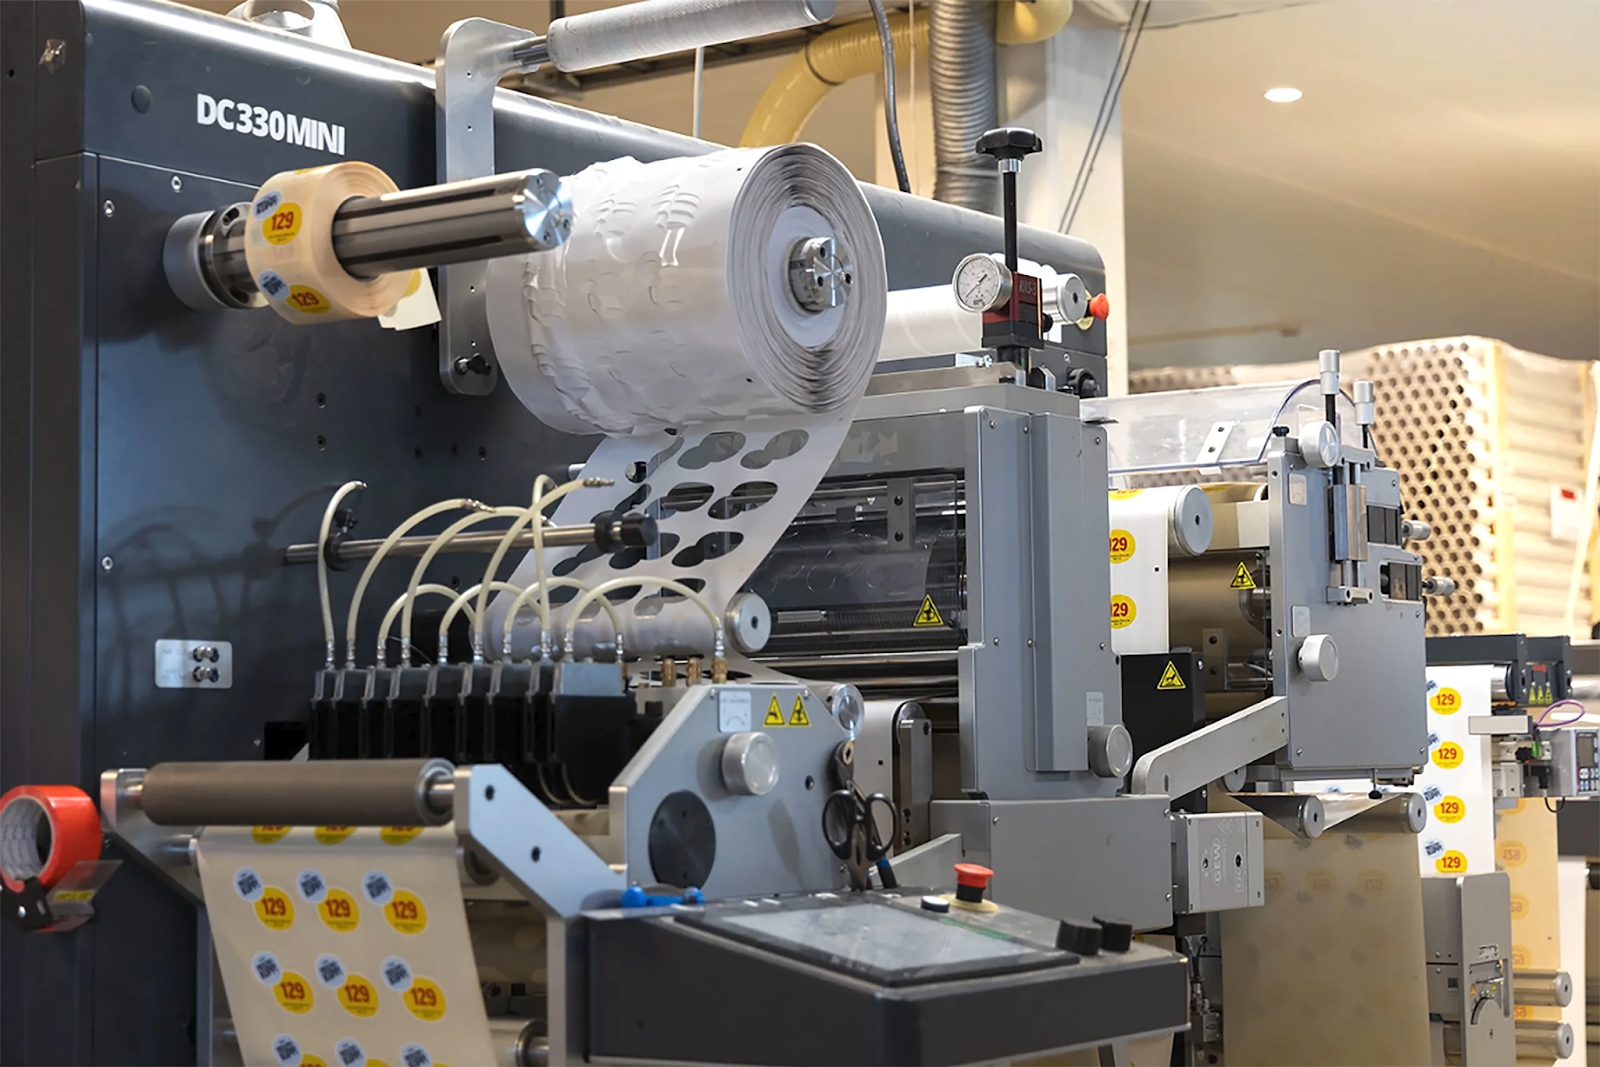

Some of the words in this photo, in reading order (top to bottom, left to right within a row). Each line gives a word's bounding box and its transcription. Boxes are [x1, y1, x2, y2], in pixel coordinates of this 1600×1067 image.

[196, 92, 346, 156] DC330MINI
[271, 211, 294, 231] 129
[291, 291, 320, 307] 129
[1436, 693, 1455, 706] 129
[1438, 747, 1457, 760] 129
[1440, 802, 1459, 814] 129
[1442, 856, 1461, 869] 129
[262, 897, 286, 916] 129
[325, 899, 351, 918] 129
[392, 901, 418, 920] 129
[280, 981, 305, 1000] 129
[344, 984, 370, 1003] 129
[411, 987, 437, 1006] 129
